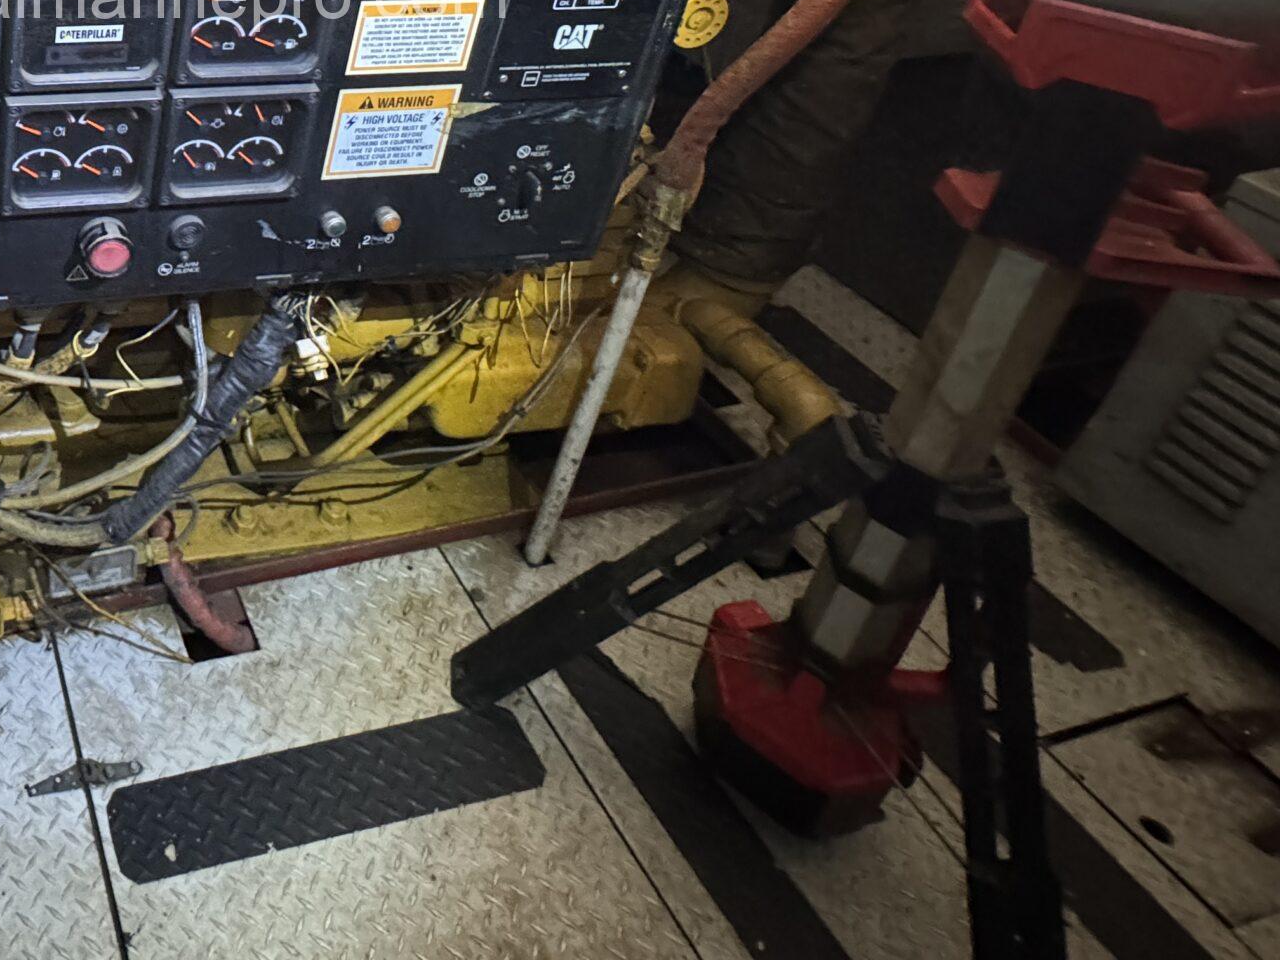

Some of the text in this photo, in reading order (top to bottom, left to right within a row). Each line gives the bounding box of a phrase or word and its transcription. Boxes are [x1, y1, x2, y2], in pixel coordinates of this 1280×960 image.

[60, 29, 117, 39] CATERPILLAR
[553, 24, 599, 50] CAT
[377, 95, 435, 109] WARNING
[362, 113, 425, 125] HIGH VOLTAGE
